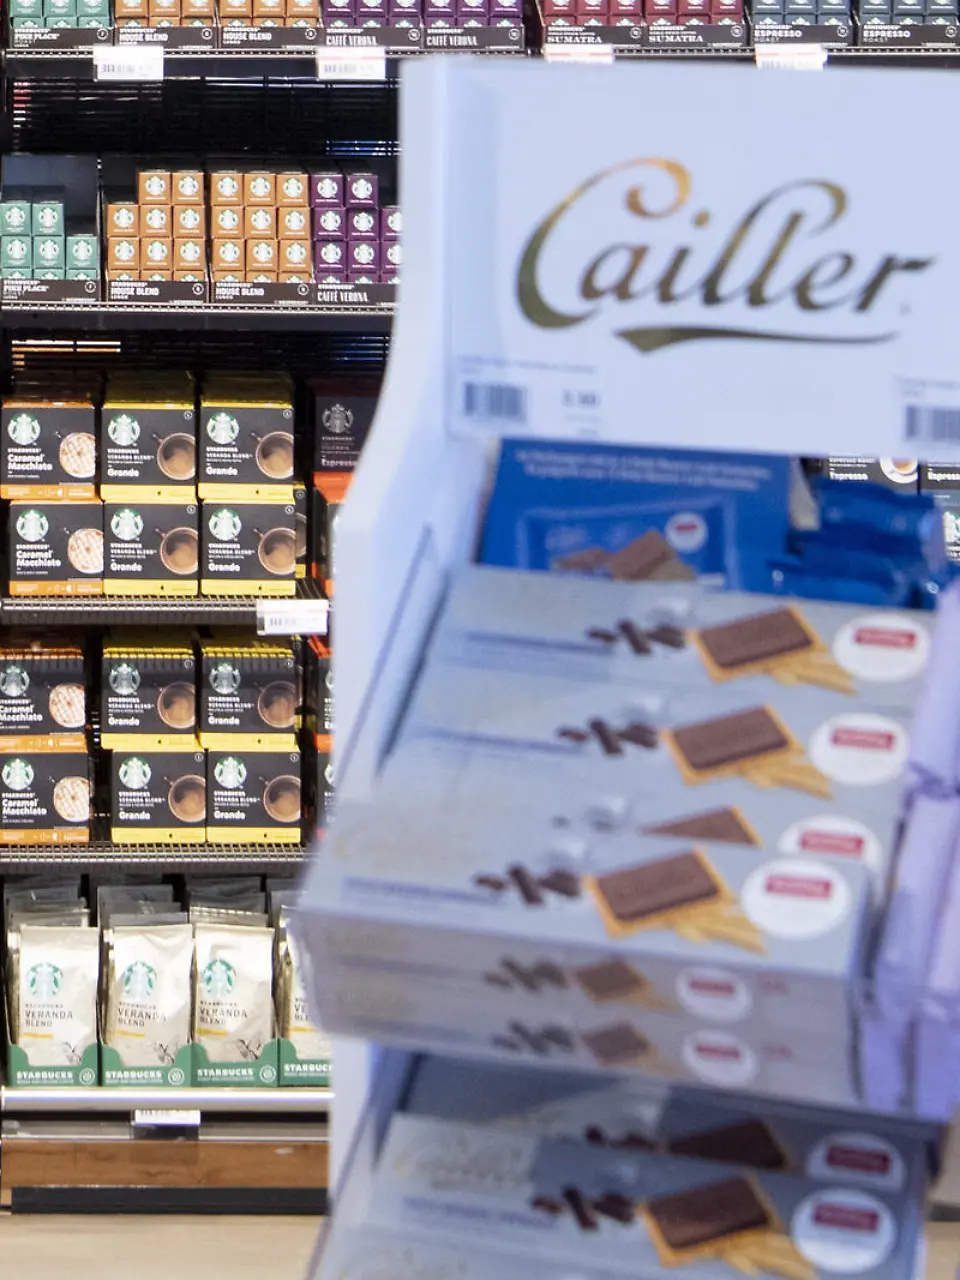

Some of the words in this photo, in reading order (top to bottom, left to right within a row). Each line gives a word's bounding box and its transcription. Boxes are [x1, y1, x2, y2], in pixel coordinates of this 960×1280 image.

[754, 30, 803, 38] ESPRESSO
[863, 30, 911, 38] ESPRESSO
[547, 36, 602, 44] SUMATRA
[648, 35, 703, 43] SUMATRA
[514, 156, 937, 332] Cailler
[7, 454, 44, 462] Caramel
[7, 463, 53, 471] Macchiato
[206, 466, 238, 475] Grande
[107, 468, 139, 477] Grande
[16, 550, 53, 559] Caramel
[16, 558, 61, 567] Macchiato
[110, 562, 142, 572] Grande
[208, 563, 241, 572] Grande
[108, 717, 140, 726] Grande
[208, 716, 240, 726] Grande
[2, 799, 39, 807] Caramel
[2, 807, 48, 816] Macchiato
[119, 811, 151, 820] Grande
[213, 811, 246, 820] Grande
[16, 1070, 73, 1080] STARBUCKS
[105, 1070, 162, 1079] STARBUCKS
[197, 1067, 253, 1076] STARBUCKS
